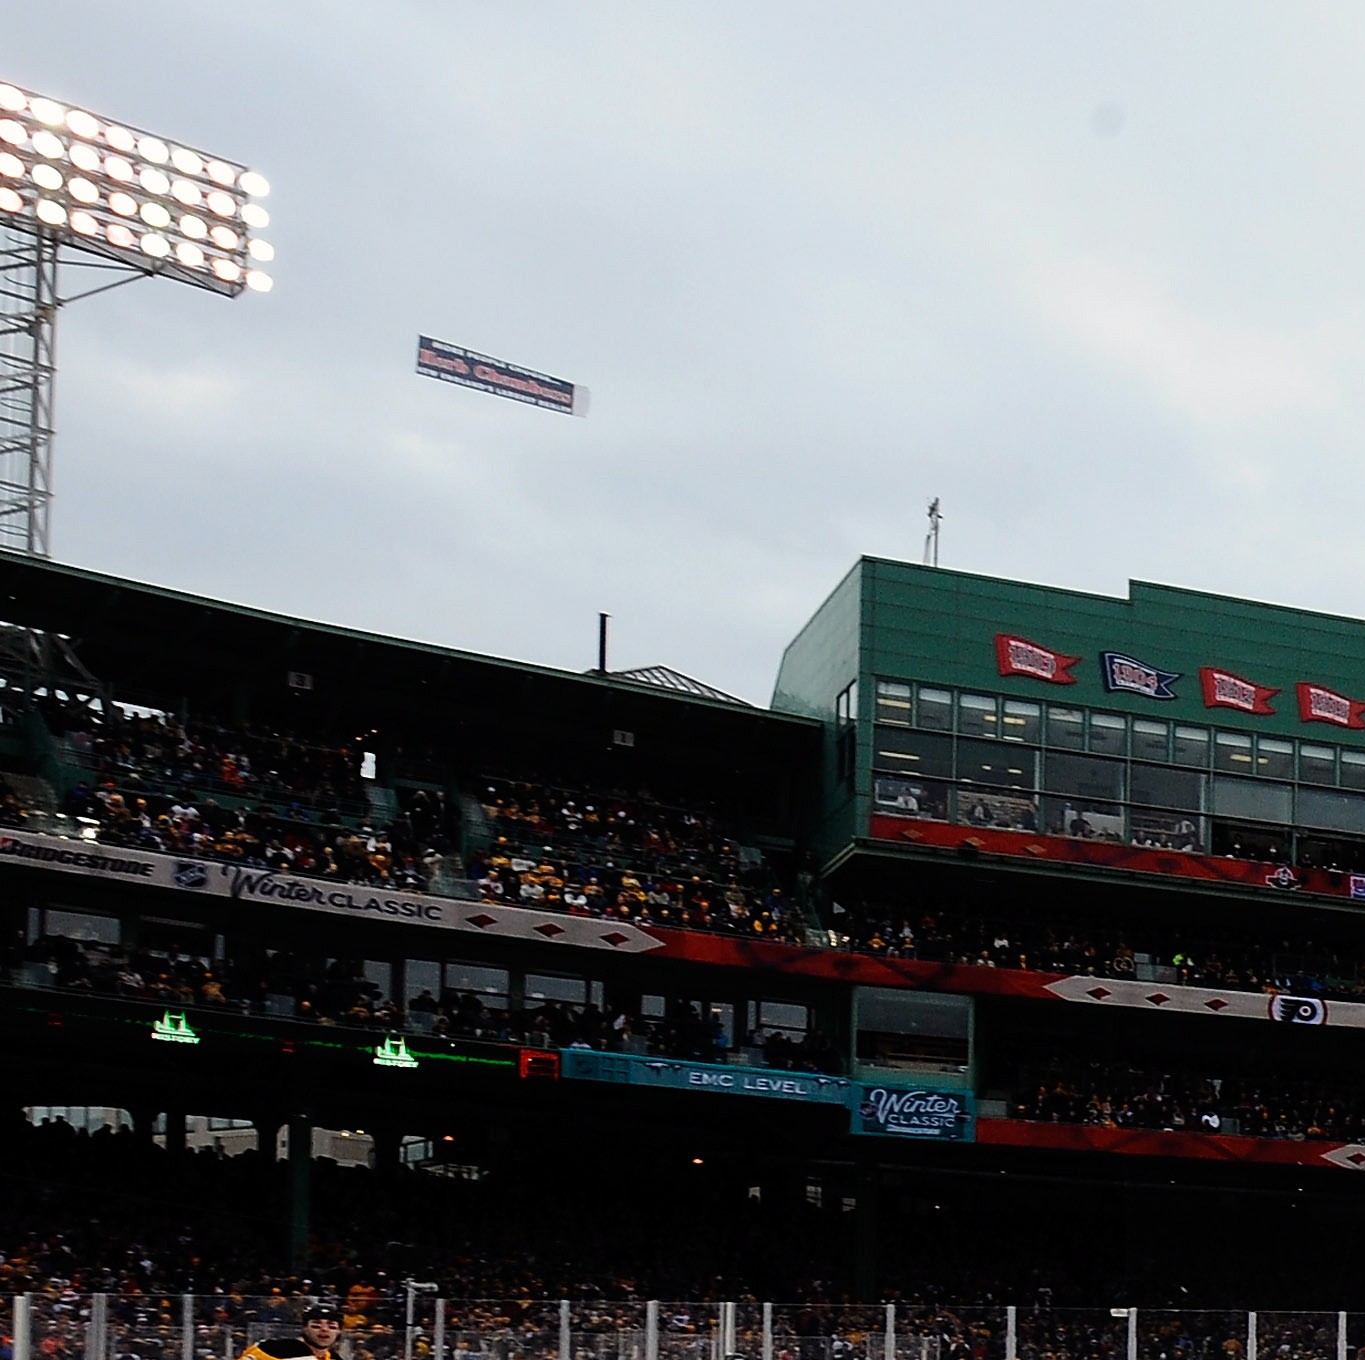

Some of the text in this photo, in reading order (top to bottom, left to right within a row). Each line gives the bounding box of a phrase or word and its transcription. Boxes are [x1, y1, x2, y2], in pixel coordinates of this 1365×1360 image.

[0, 837, 155, 878] BRIDGESTONE
[219, 865, 443, 922] Winter CLASSIC
[688, 1071, 808, 1095] EMC LEVEL
[868, 1088, 961, 1125] Winter
[887, 1113, 956, 1129] CLASSIC
